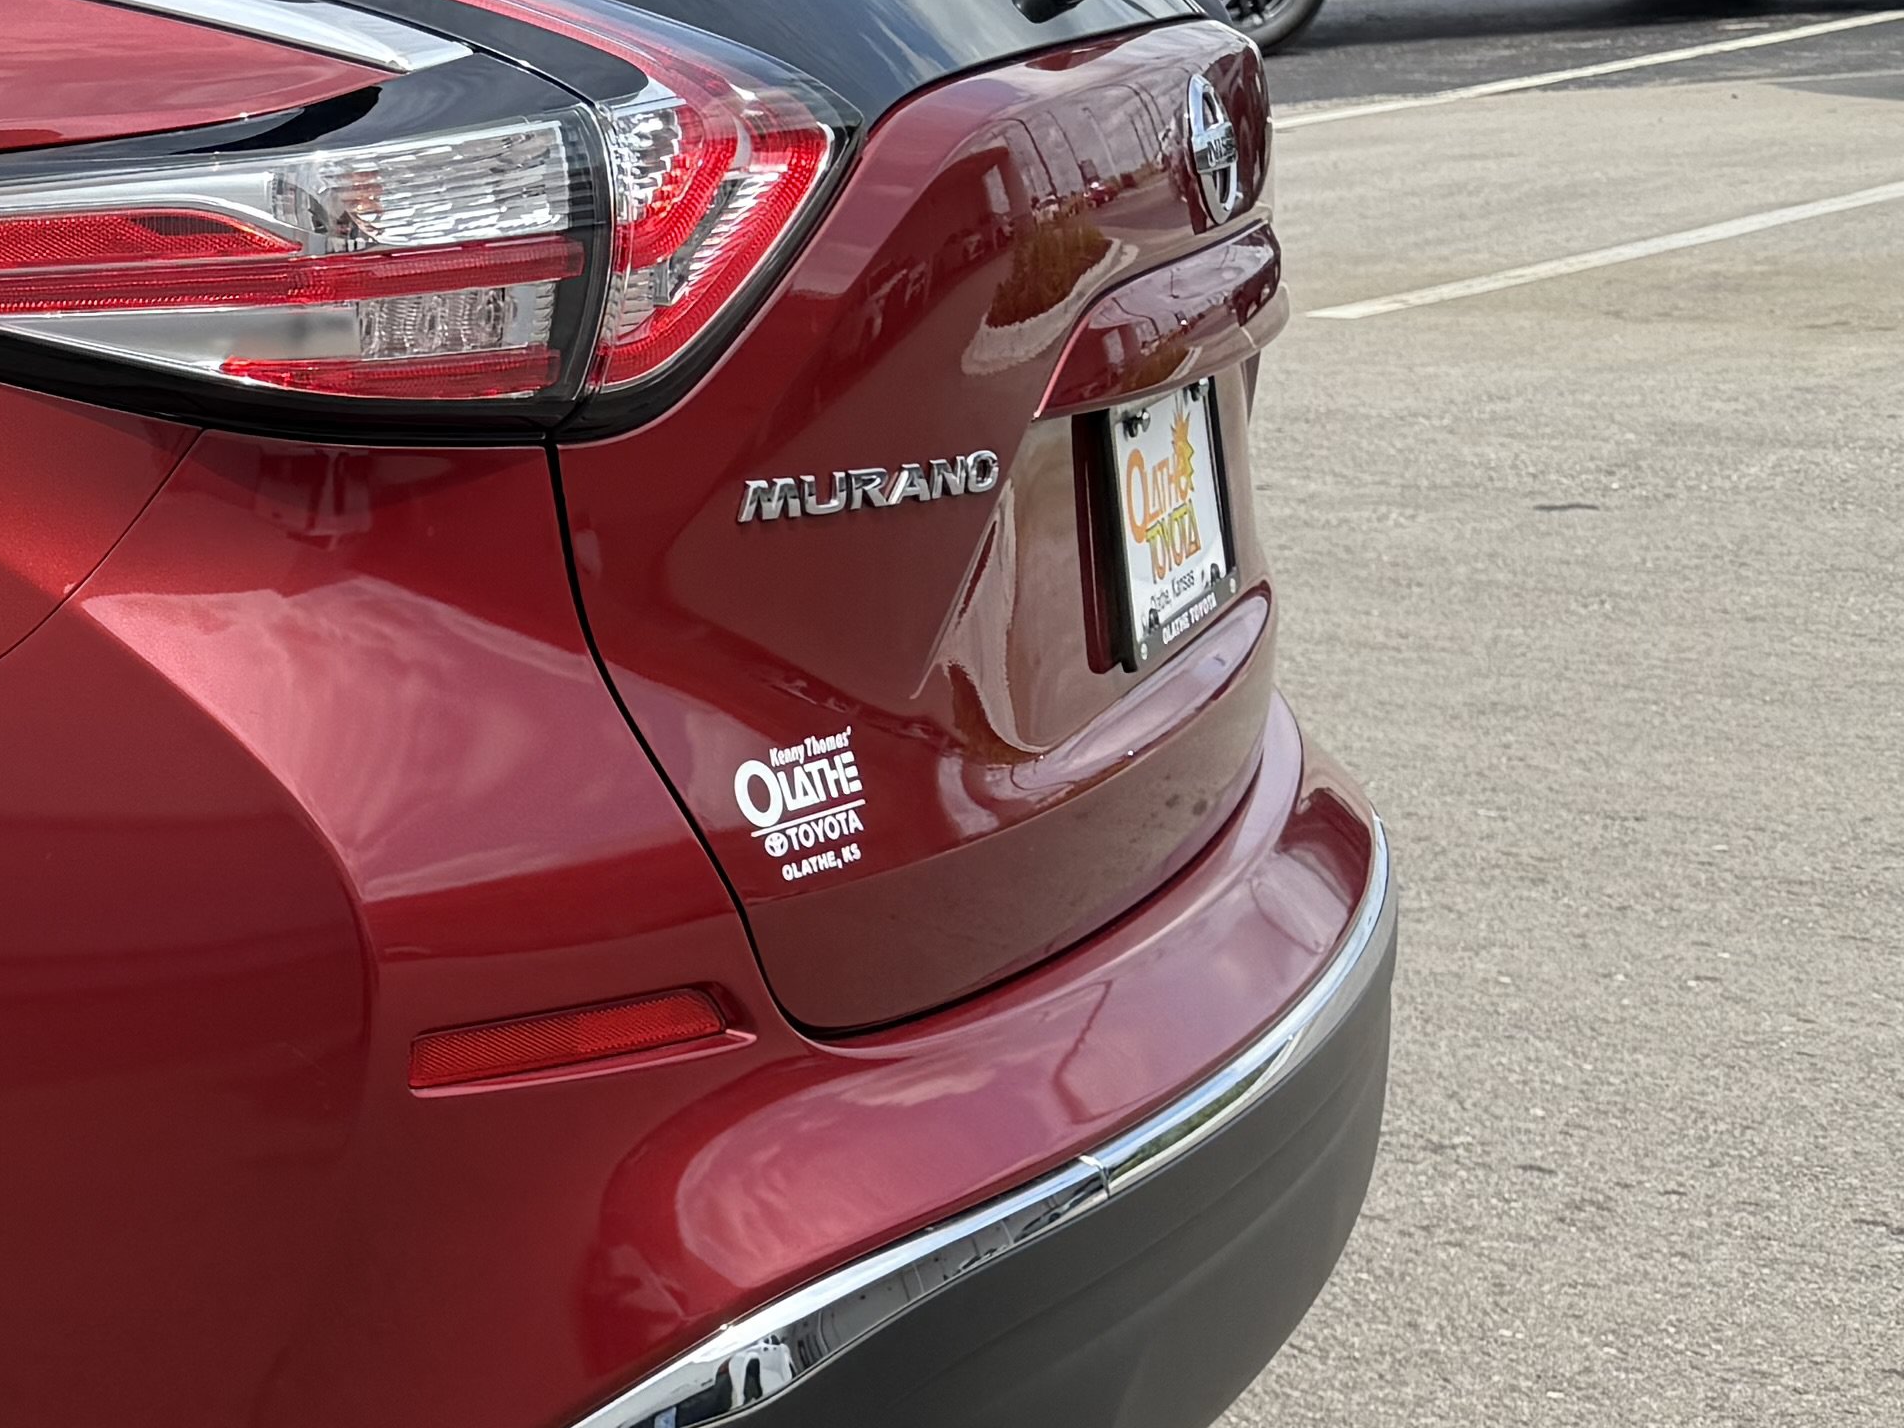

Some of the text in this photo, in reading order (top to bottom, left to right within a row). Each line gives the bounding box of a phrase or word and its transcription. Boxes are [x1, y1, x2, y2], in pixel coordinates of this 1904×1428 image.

[737, 450, 1000, 522] MURANO
[1146, 500, 1202, 584] TOYOTA
[1188, 592, 1217, 624] TOYOTA
[769, 743, 805, 768] Kenny
[734, 750, 863, 828] OLATHE
[785, 809, 865, 851] TOYOTA
[781, 842, 862, 881] OLATHE, KS
